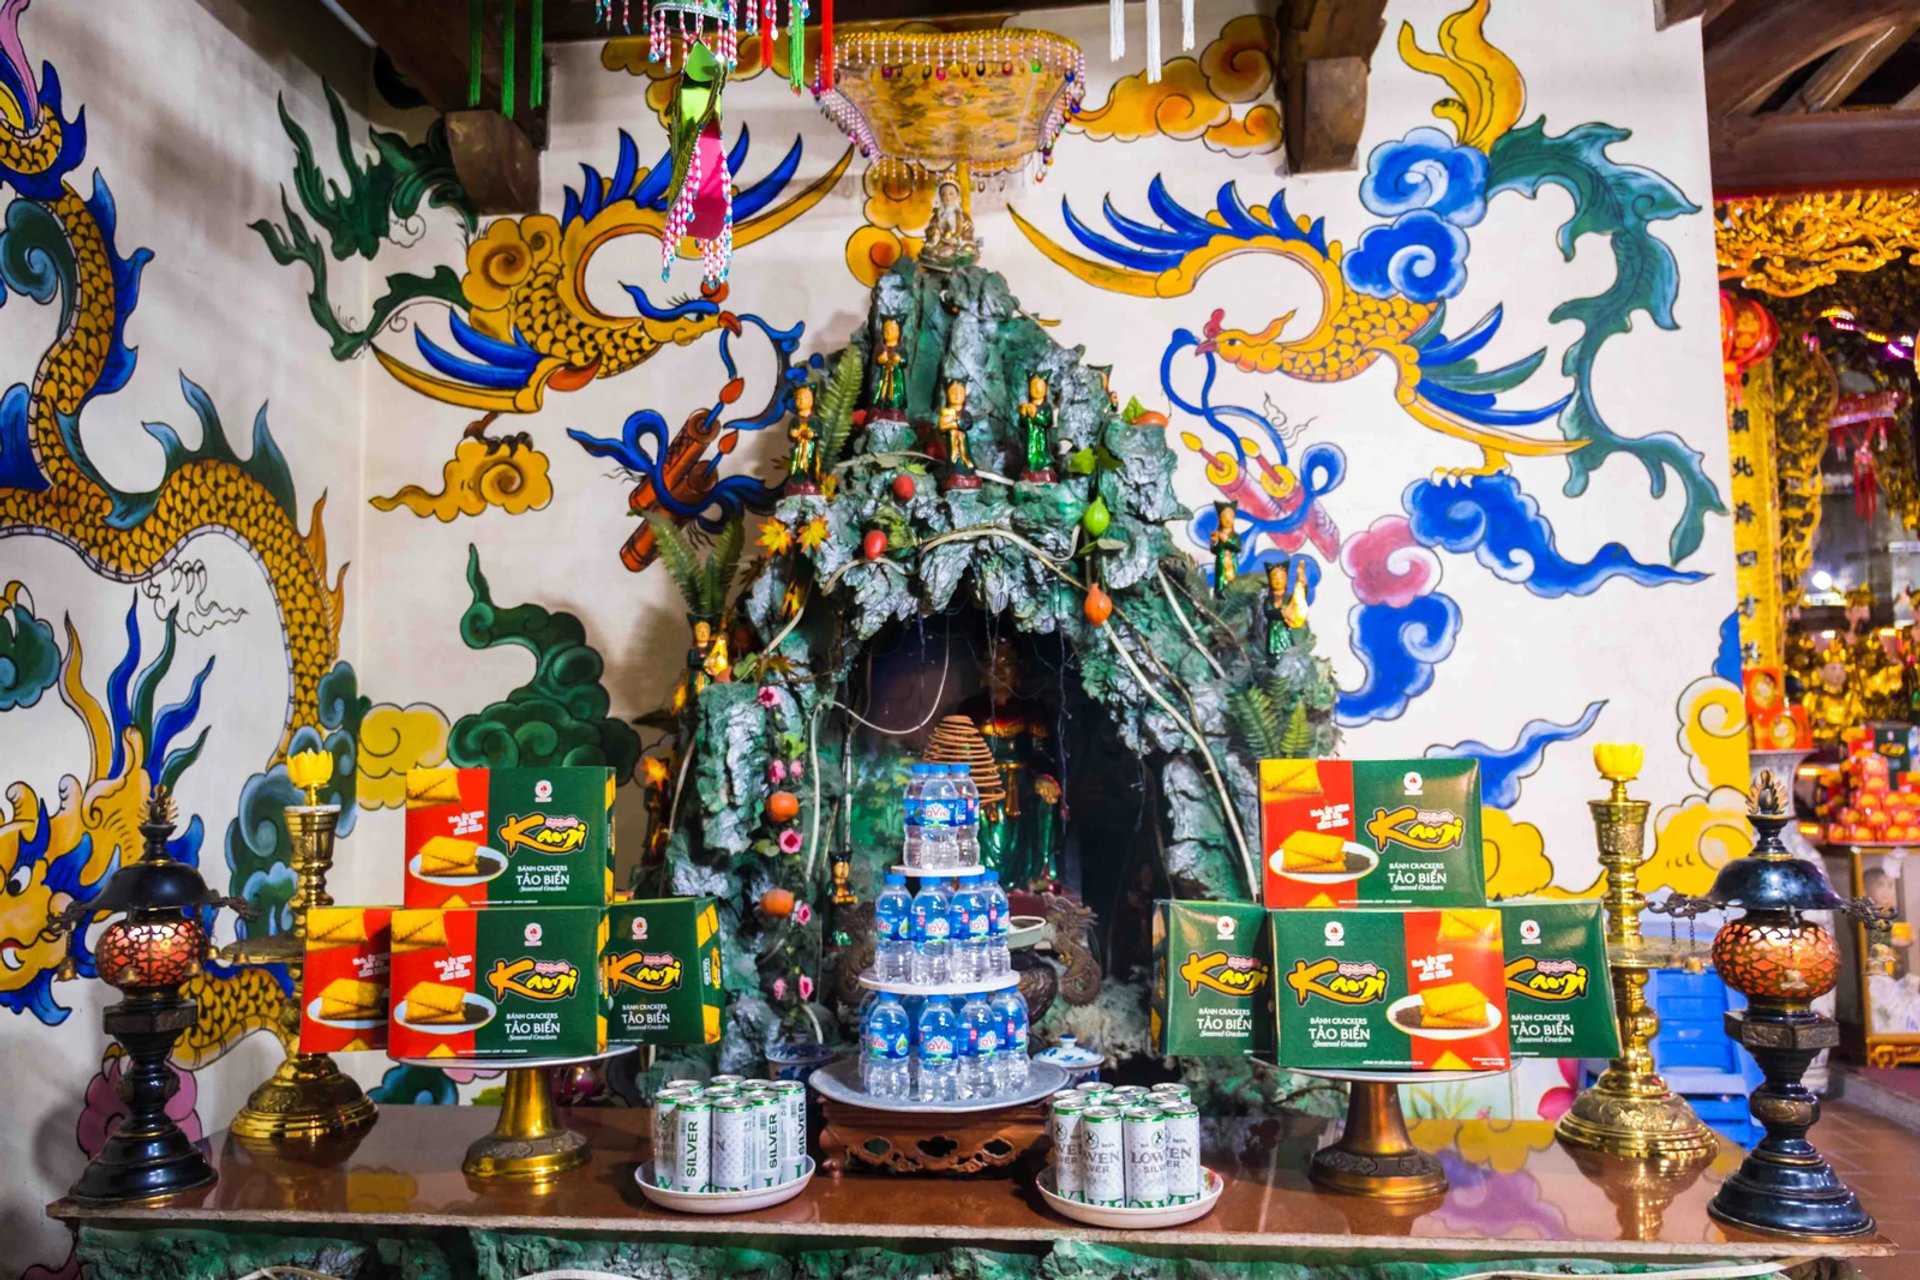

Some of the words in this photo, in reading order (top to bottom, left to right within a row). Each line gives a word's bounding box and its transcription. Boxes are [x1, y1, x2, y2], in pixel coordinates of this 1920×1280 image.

[537, 864, 567, 872] CRACKERS
[1410, 862, 1444, 870] CRACKERS
[515, 872, 541, 885] TẢO
[543, 870, 570, 885] BIỂN
[1387, 870, 1415, 884] TẢO
[1419, 868, 1447, 884] BIỂN
[526, 1012, 558, 1020] CRACKERS
[621, 1012, 644, 1024] TẢO
[646, 1009, 670, 1024] BIỂN
[1219, 1007, 1250, 1015] CRACKERS
[505, 1021, 531, 1034] TẢO
[533, 1018, 560, 1034] BIỂN
[1197, 1017, 1223, 1029] TẢO
[1225, 1014, 1252, 1029] BIỂN
[1332, 1016, 1368, 1025] CRACKERS
[1511, 1022, 1541, 1036] TẢO
[1543, 1019, 1574, 1036] BIỂN
[1308, 1025, 1338, 1040] TẢO
[1340, 1024, 1370, 1040] BIỂN
[769, 1113, 778, 1169] SILVER
[686, 1121, 698, 1178] SILVER
